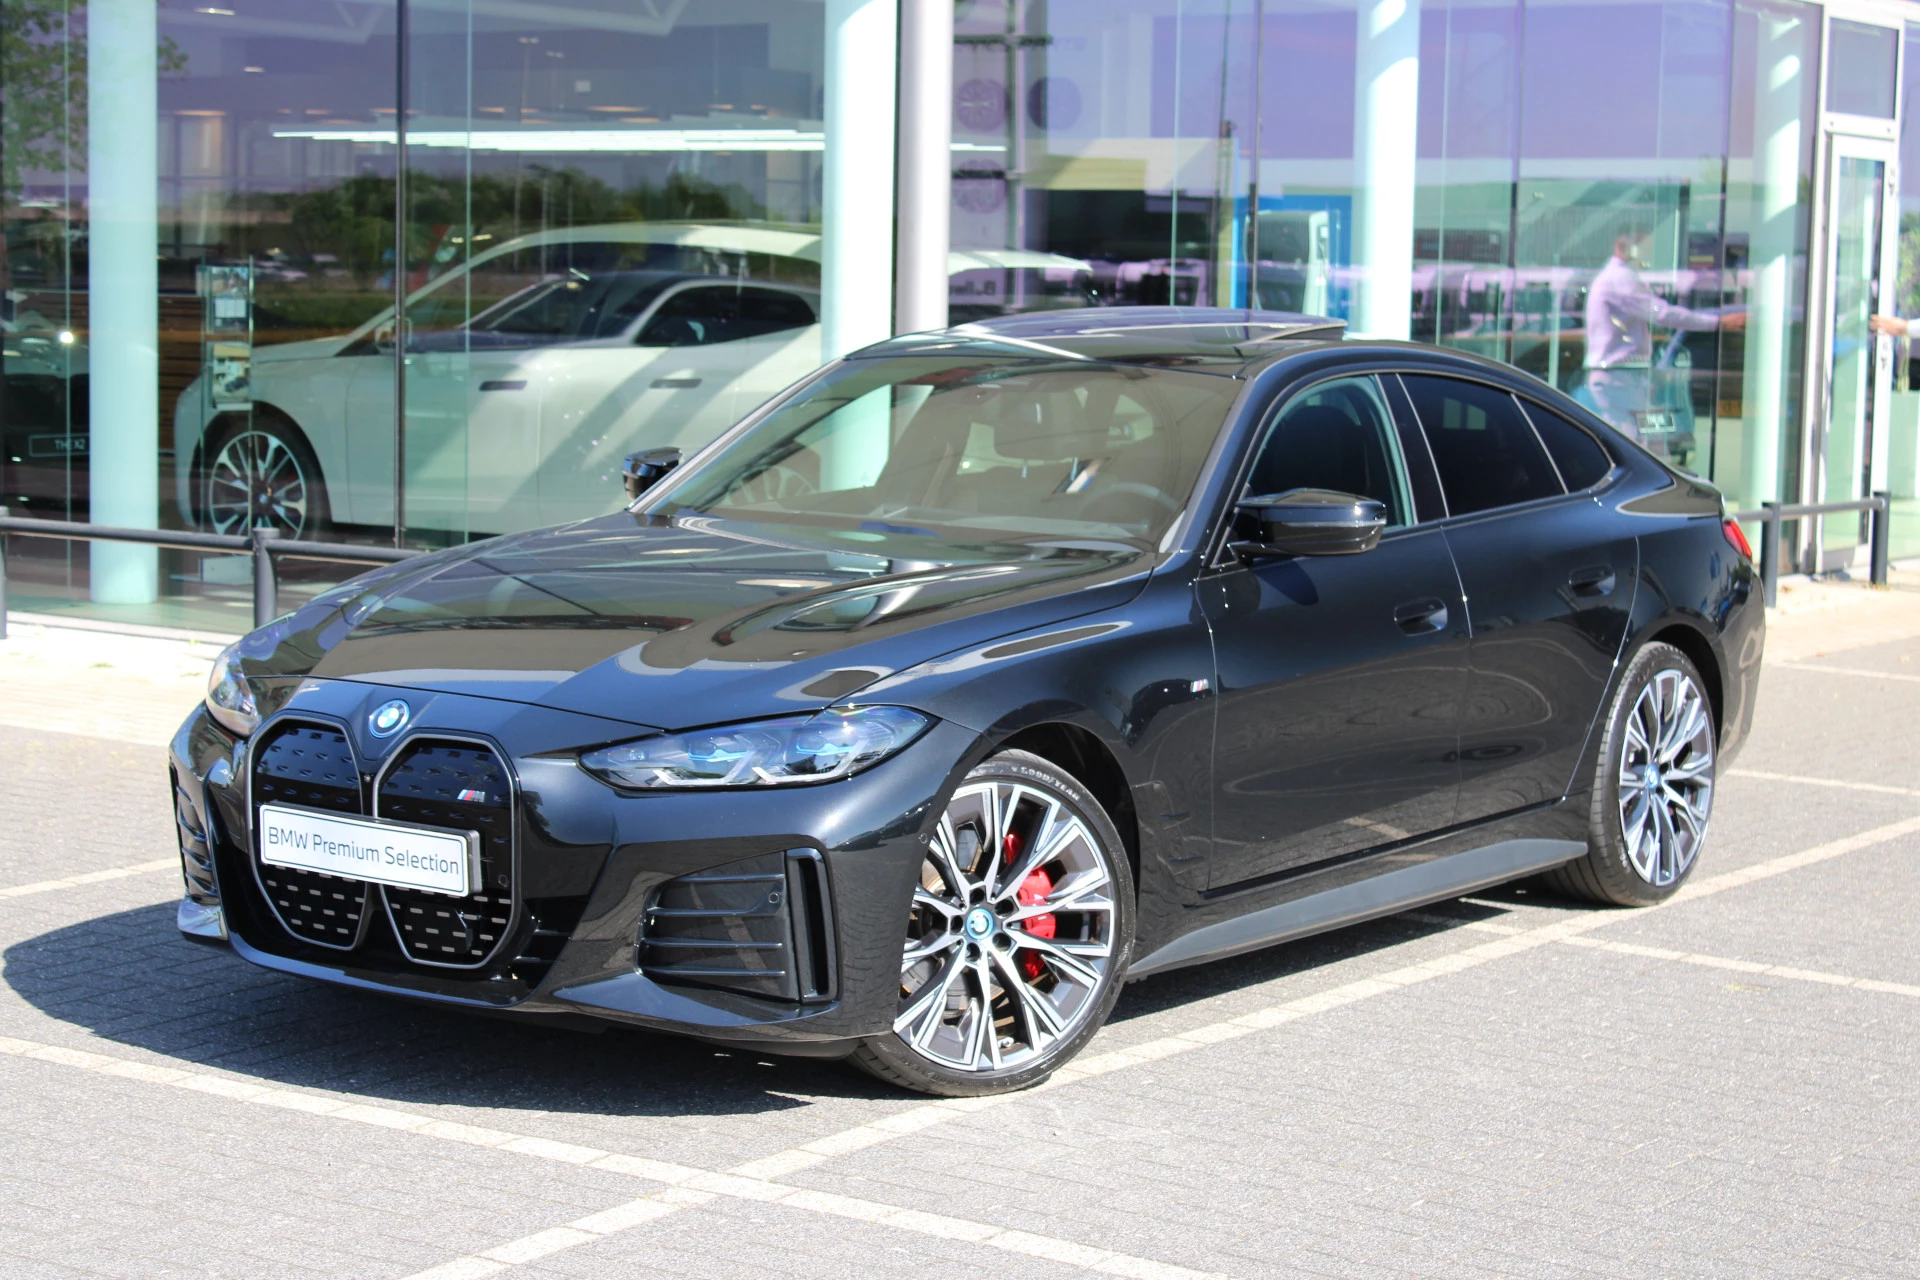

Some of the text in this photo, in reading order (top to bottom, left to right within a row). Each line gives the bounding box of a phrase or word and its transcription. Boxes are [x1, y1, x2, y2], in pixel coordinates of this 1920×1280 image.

[268, 826, 459, 875] BMW Premium Selection
